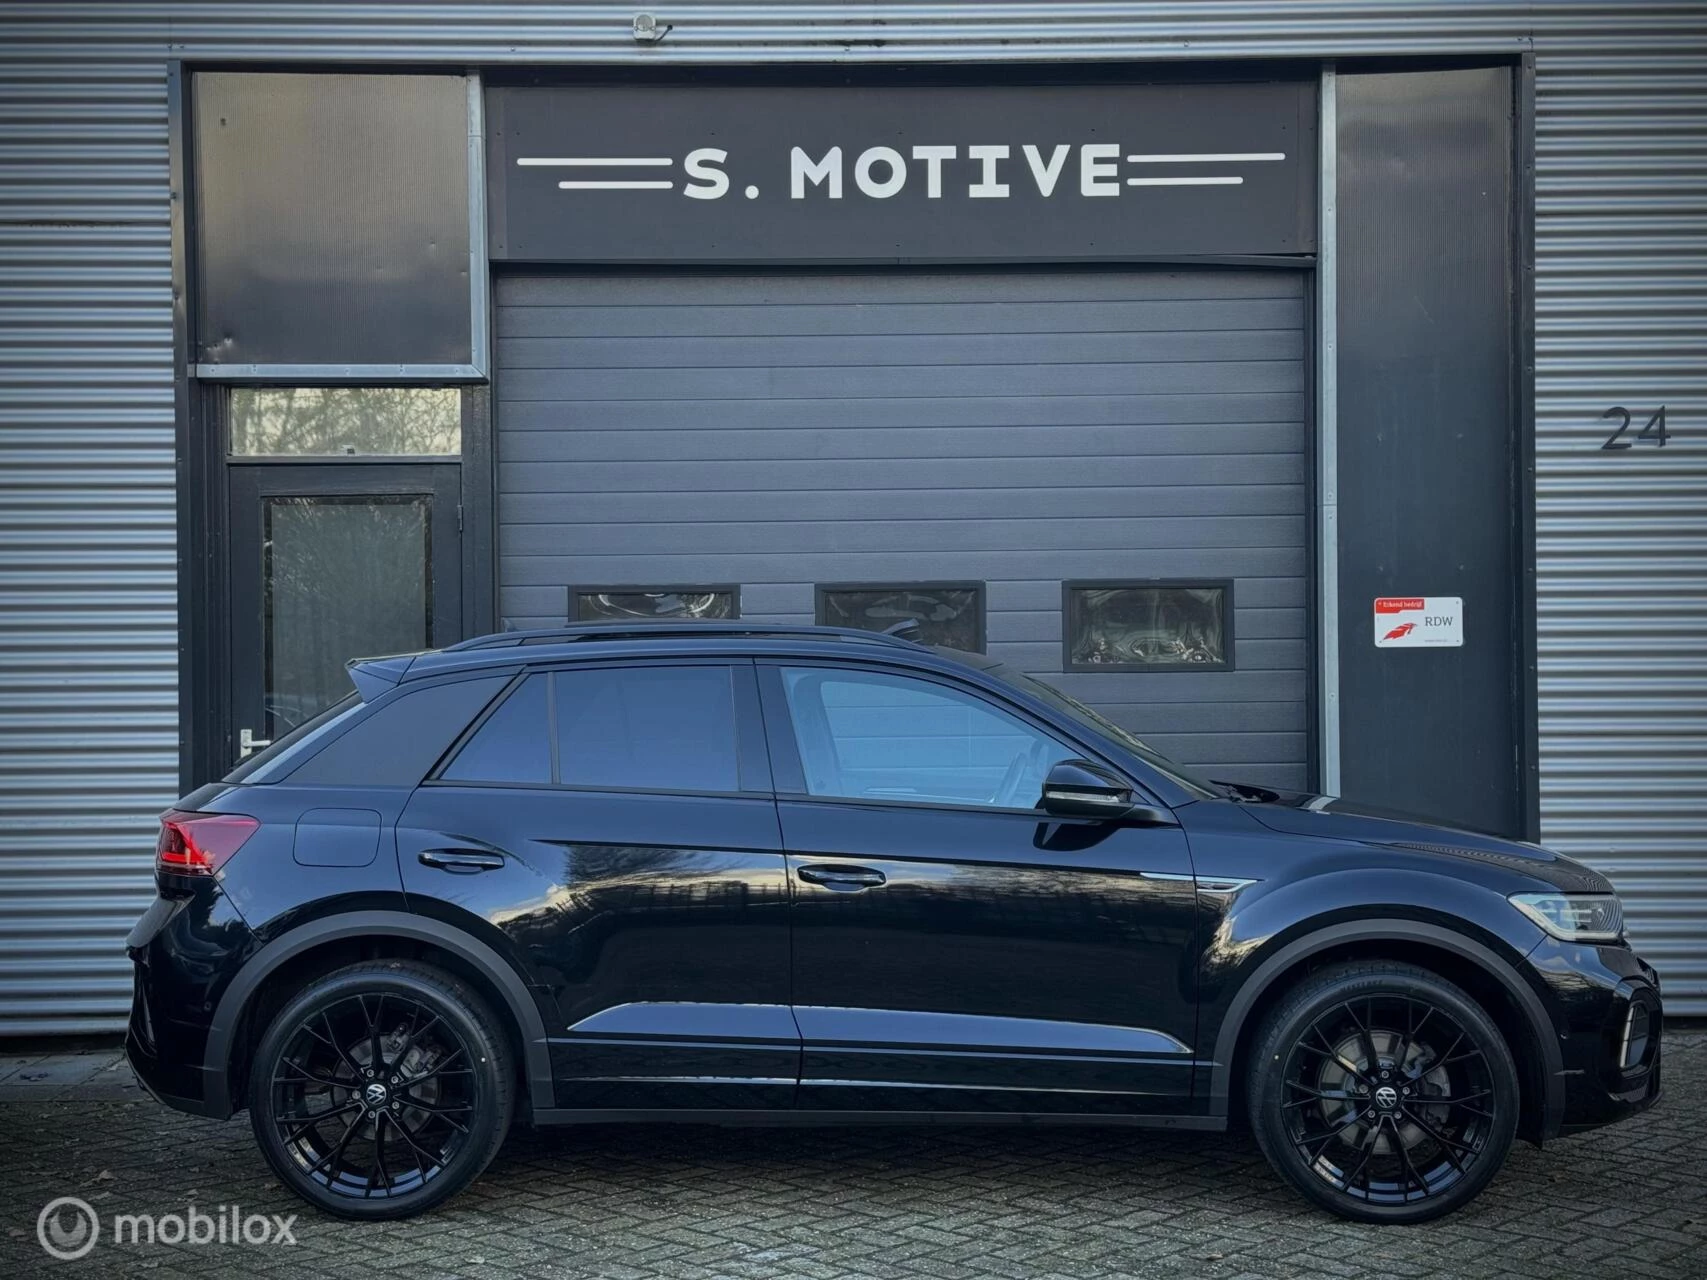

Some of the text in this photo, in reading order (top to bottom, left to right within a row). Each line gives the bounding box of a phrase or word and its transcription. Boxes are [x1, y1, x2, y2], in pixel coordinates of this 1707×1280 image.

[683, 143, 1121, 200] S. MOTIVE
[1601, 405, 1671, 450] 24
[1424, 616, 1454, 627] RDW
